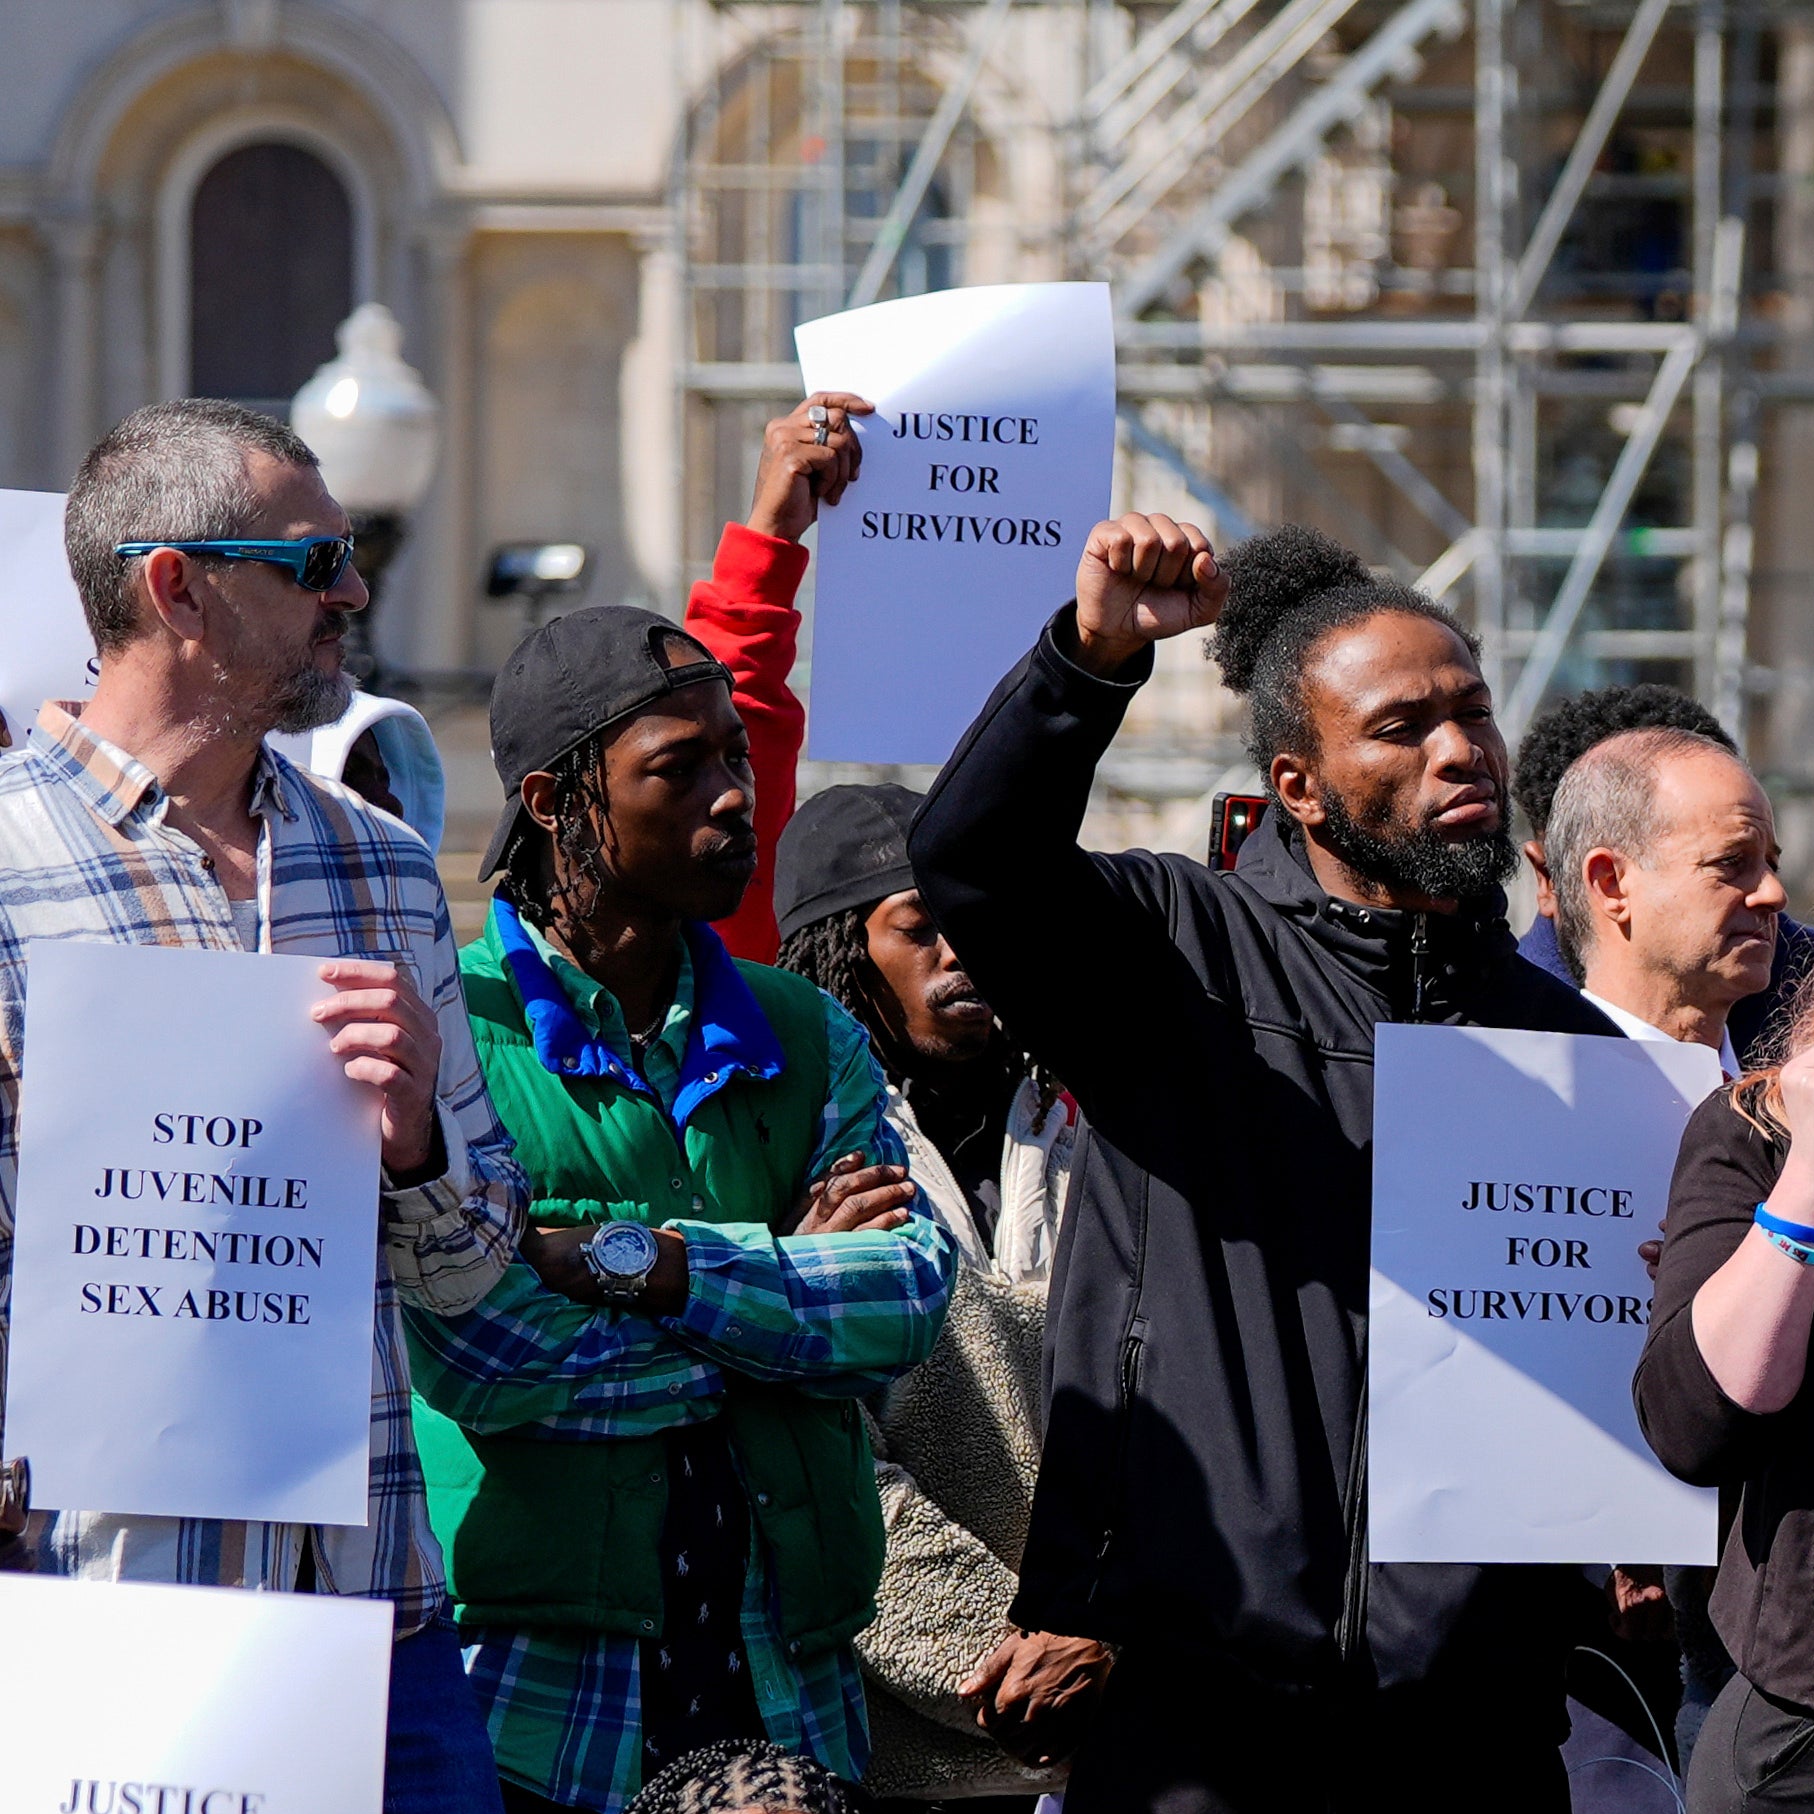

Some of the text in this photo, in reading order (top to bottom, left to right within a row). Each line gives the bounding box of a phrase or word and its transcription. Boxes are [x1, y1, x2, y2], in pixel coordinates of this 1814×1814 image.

[893, 413, 1039, 445] JUSTICE
[929, 464, 1000, 493] FOR
[862, 511, 1061, 547] SURVIVORS
[153, 1113, 263, 1148] STOP
[95, 1168, 307, 1209] JUVENILE
[1462, 1182, 1634, 1218] JUSTICE
[72, 1224, 324, 1268] DETENTION
[1506, 1237, 1592, 1268] FOR
[81, 1283, 310, 1324] SEX ABUSE
